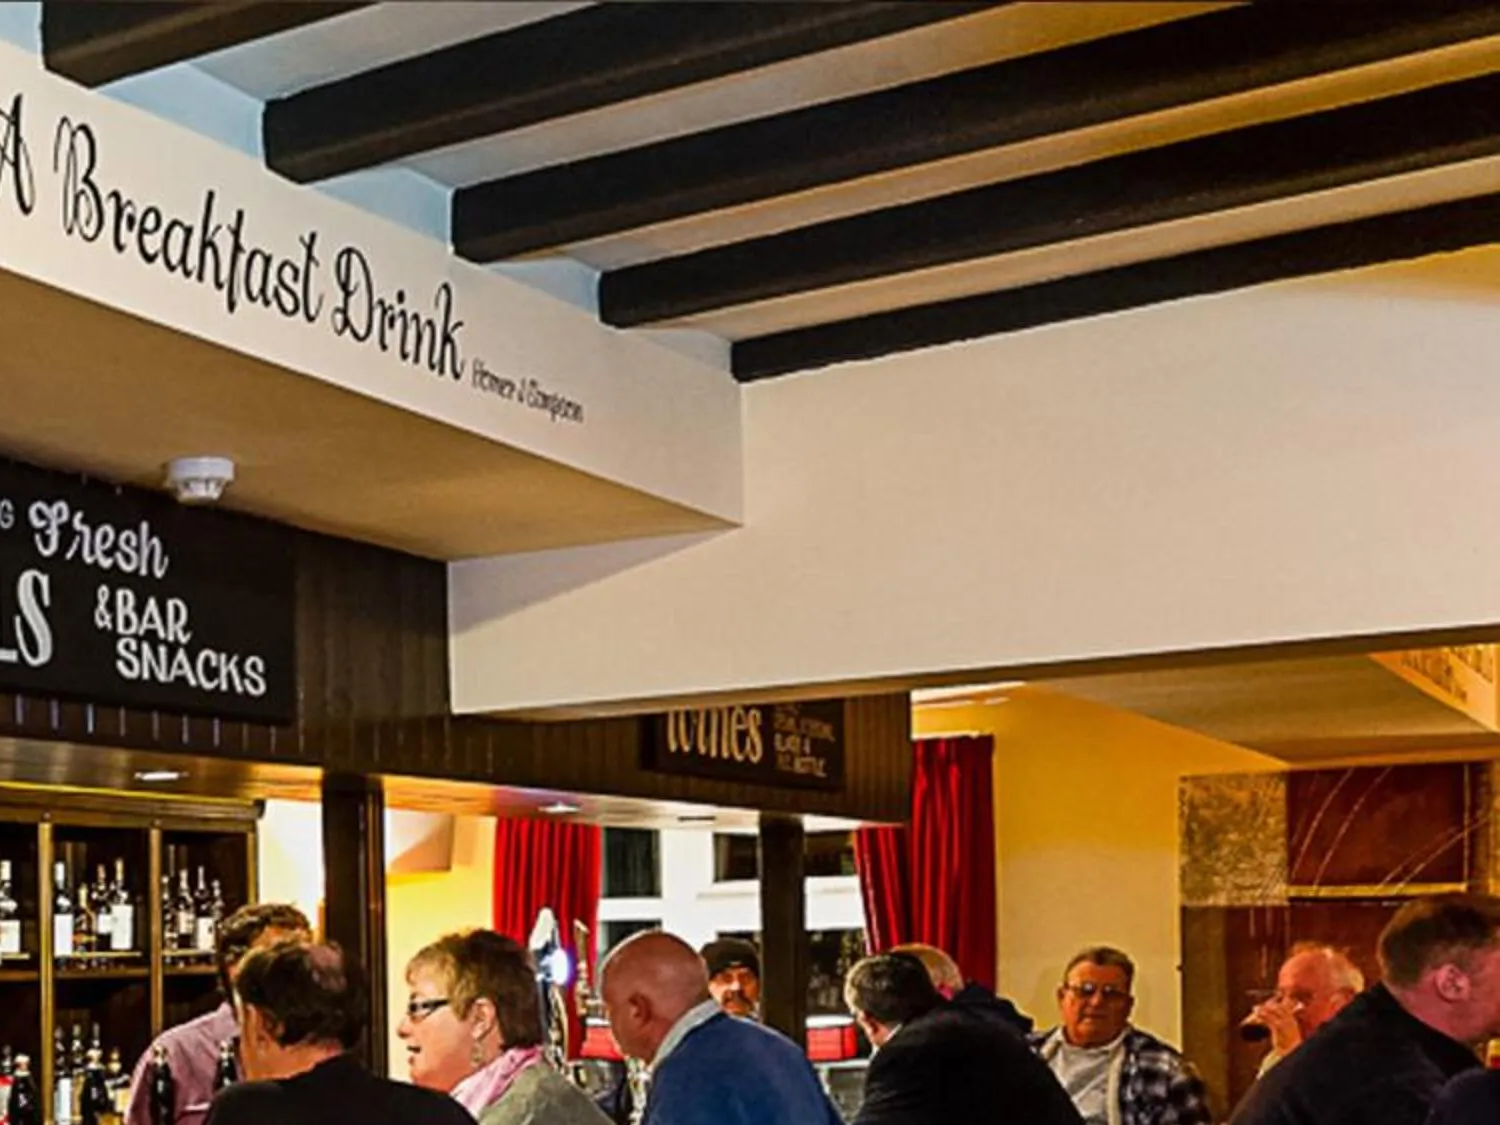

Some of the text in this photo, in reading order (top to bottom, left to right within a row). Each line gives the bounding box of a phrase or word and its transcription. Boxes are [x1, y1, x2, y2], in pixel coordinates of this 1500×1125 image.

[53, 116, 324, 323] Breakfast
[333, 246, 466, 380] Drink
[28, 500, 169, 580] Fresh
[116, 637, 267, 697] SNACKS
